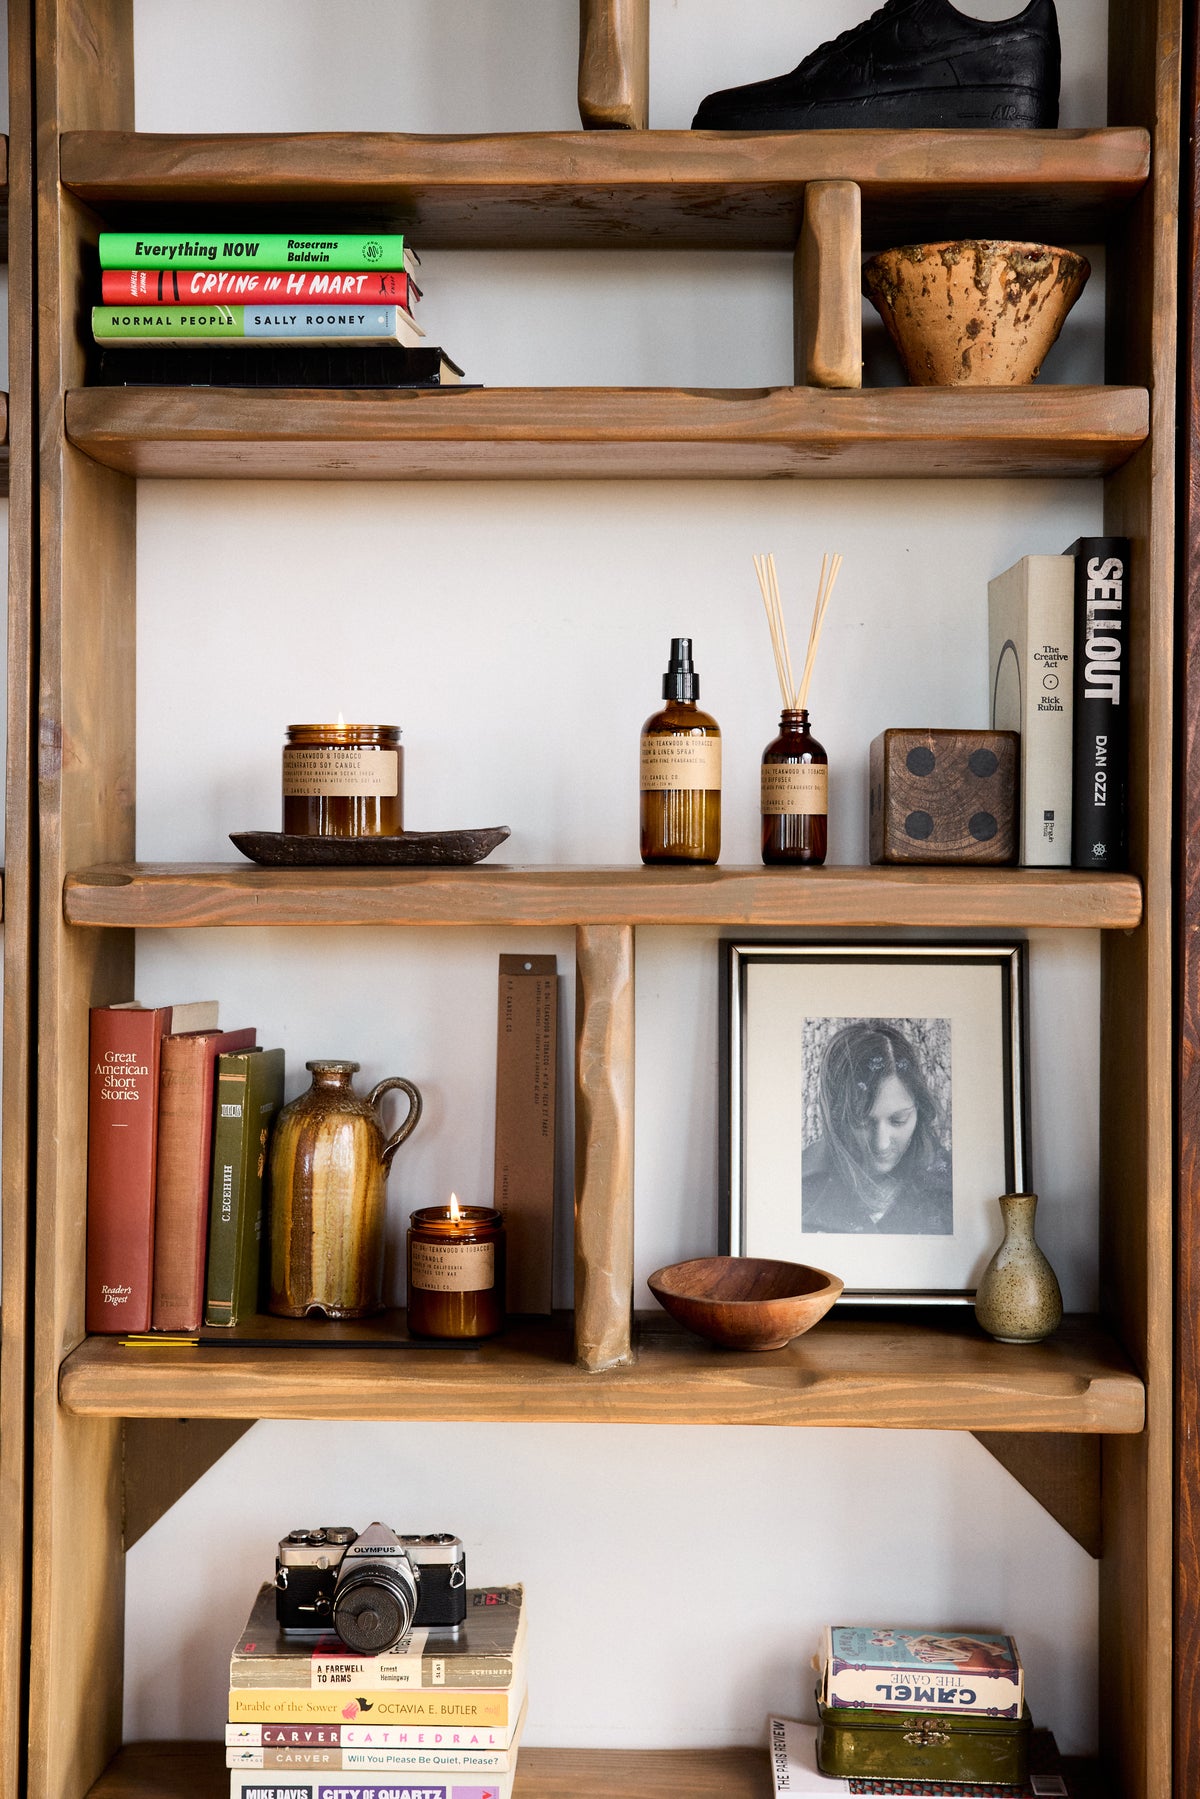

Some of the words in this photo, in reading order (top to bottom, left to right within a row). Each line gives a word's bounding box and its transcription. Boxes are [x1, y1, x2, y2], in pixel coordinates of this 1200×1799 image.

[287, 239, 338, 249] Rosecrans
[135, 241, 218, 260] Everything
[222, 242, 260, 257] NOW
[287, 251, 330, 262] Baldwin
[190, 272, 259, 294] CRYING
[286, 273, 306, 295] H
[309, 274, 369, 295] MART
[111, 316, 172, 326] NORMAL
[180, 316, 233, 325] PEOPLE
[254, 316, 297, 325] SALLY
[306, 315, 365, 325] ROONEY
[1084, 556, 1124, 705] SELLOUT
[1042, 645, 1060, 653] The
[1033, 652, 1069, 661] Creative
[1043, 660, 1058, 668] Act
[1041, 696, 1060, 704] Rick
[1037, 703, 1064, 712] Rubin
[1095, 735, 1108, 767] DAN
[1094, 771, 1107, 807] OZZI
[104, 1050, 138, 1063] Great
[94, 1063, 149, 1075] American
[104, 1075, 137, 1088] Short
[101, 1087, 140, 1100] Stories
[101, 1285, 132, 1294] Reader's
[104, 1294, 128, 1306] Digest
[353, 1546, 396, 1554] OLYMPUS
[317, 1665, 323, 1674] A
[325, 1664, 365, 1673] FAREWELL
[380, 1665, 398, 1673] Ernest
[317, 1674, 327, 1683] TO
[330, 1674, 352, 1683] ARMS
[380, 1674, 410, 1682] Hemingway
[890, 1673, 931, 1686] GAME
[935, 1676, 964, 1687] THE
[875, 1684, 977, 1705] CAMEL
[236, 1700, 271, 1711] Parable
[274, 1701, 286, 1712] of
[287, 1702, 303, 1712] the
[306, 1702, 338, 1713] Sower
[377, 1703, 425, 1714] OCTAVIA
[428, 1704, 438, 1714] E.
[440, 1705, 478, 1715] BUTLER
[263, 1731, 338, 1742] CARVER
[347, 1732, 495, 1744] CATHEDRAL
[772, 1720, 787, 1752] REVIEW
[276, 1754, 330, 1763] CARVER
[348, 1755, 365, 1763] Will
[367, 1755, 384, 1763] You
[386, 1756, 416, 1764] Please
[418, 1756, 431, 1764] Be
[432, 1756, 461, 1765] Quiet,
[463, 1757, 499, 1765] Please?
[775, 1753, 788, 1773] PARIS
[777, 1775, 790, 1791] THE
[245, 1789, 275, 1799] MIKE
[276, 1789, 308, 1799] DAVIS
[322, 1789, 360, 1799] CITY
[362, 1789, 376, 1799] OF
[377, 1789, 442, 1799] QUARTZ
